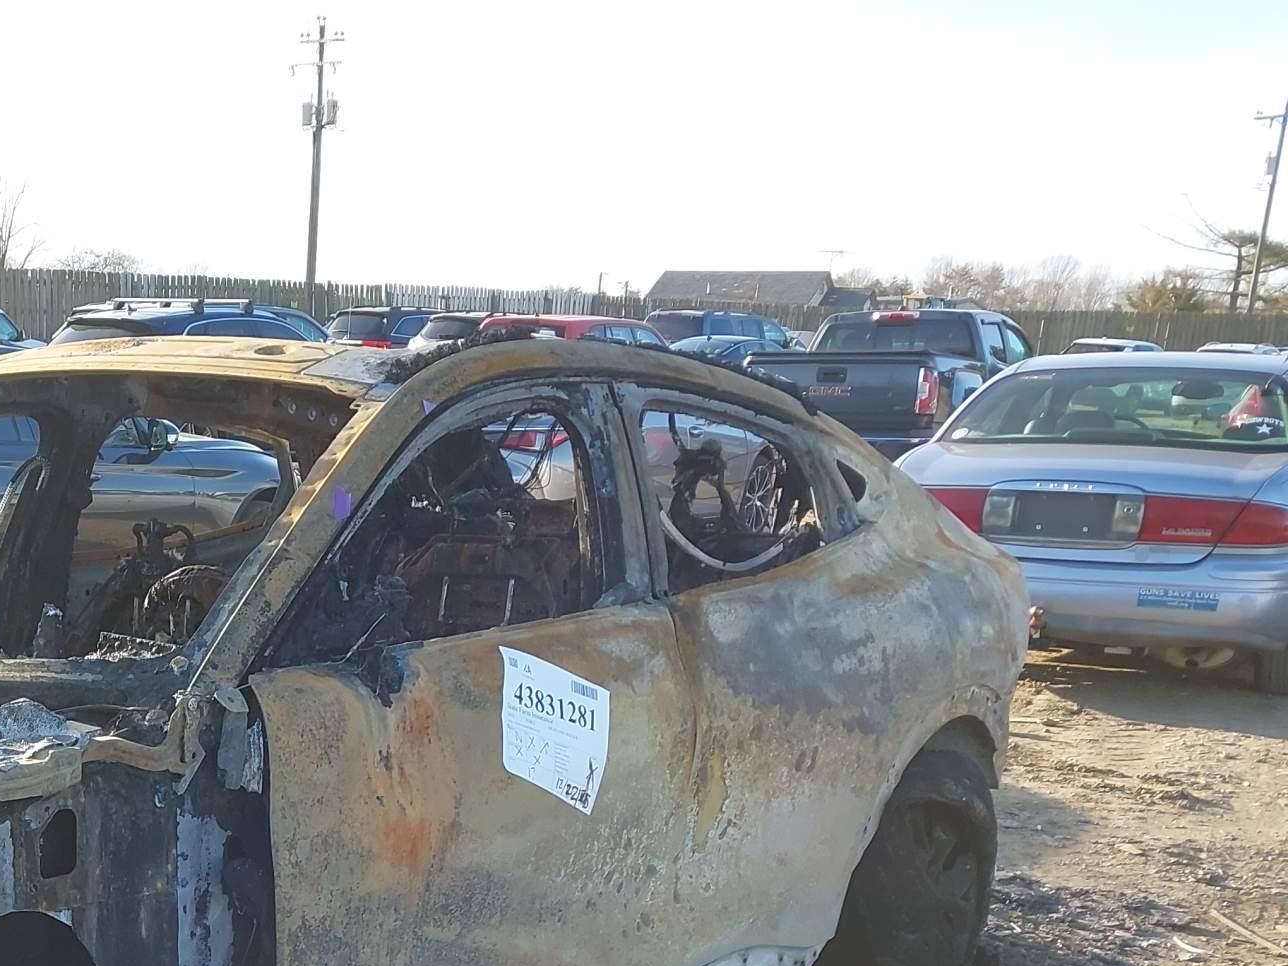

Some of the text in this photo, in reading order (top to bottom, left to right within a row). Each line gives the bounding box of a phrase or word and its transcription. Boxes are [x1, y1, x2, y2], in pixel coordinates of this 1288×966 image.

[809, 386, 851, 396] GMC
[1139, 588, 1165, 596] GUNS
[1167, 590, 1192, 598] SAVE
[513, 682, 596, 732] 43831281
